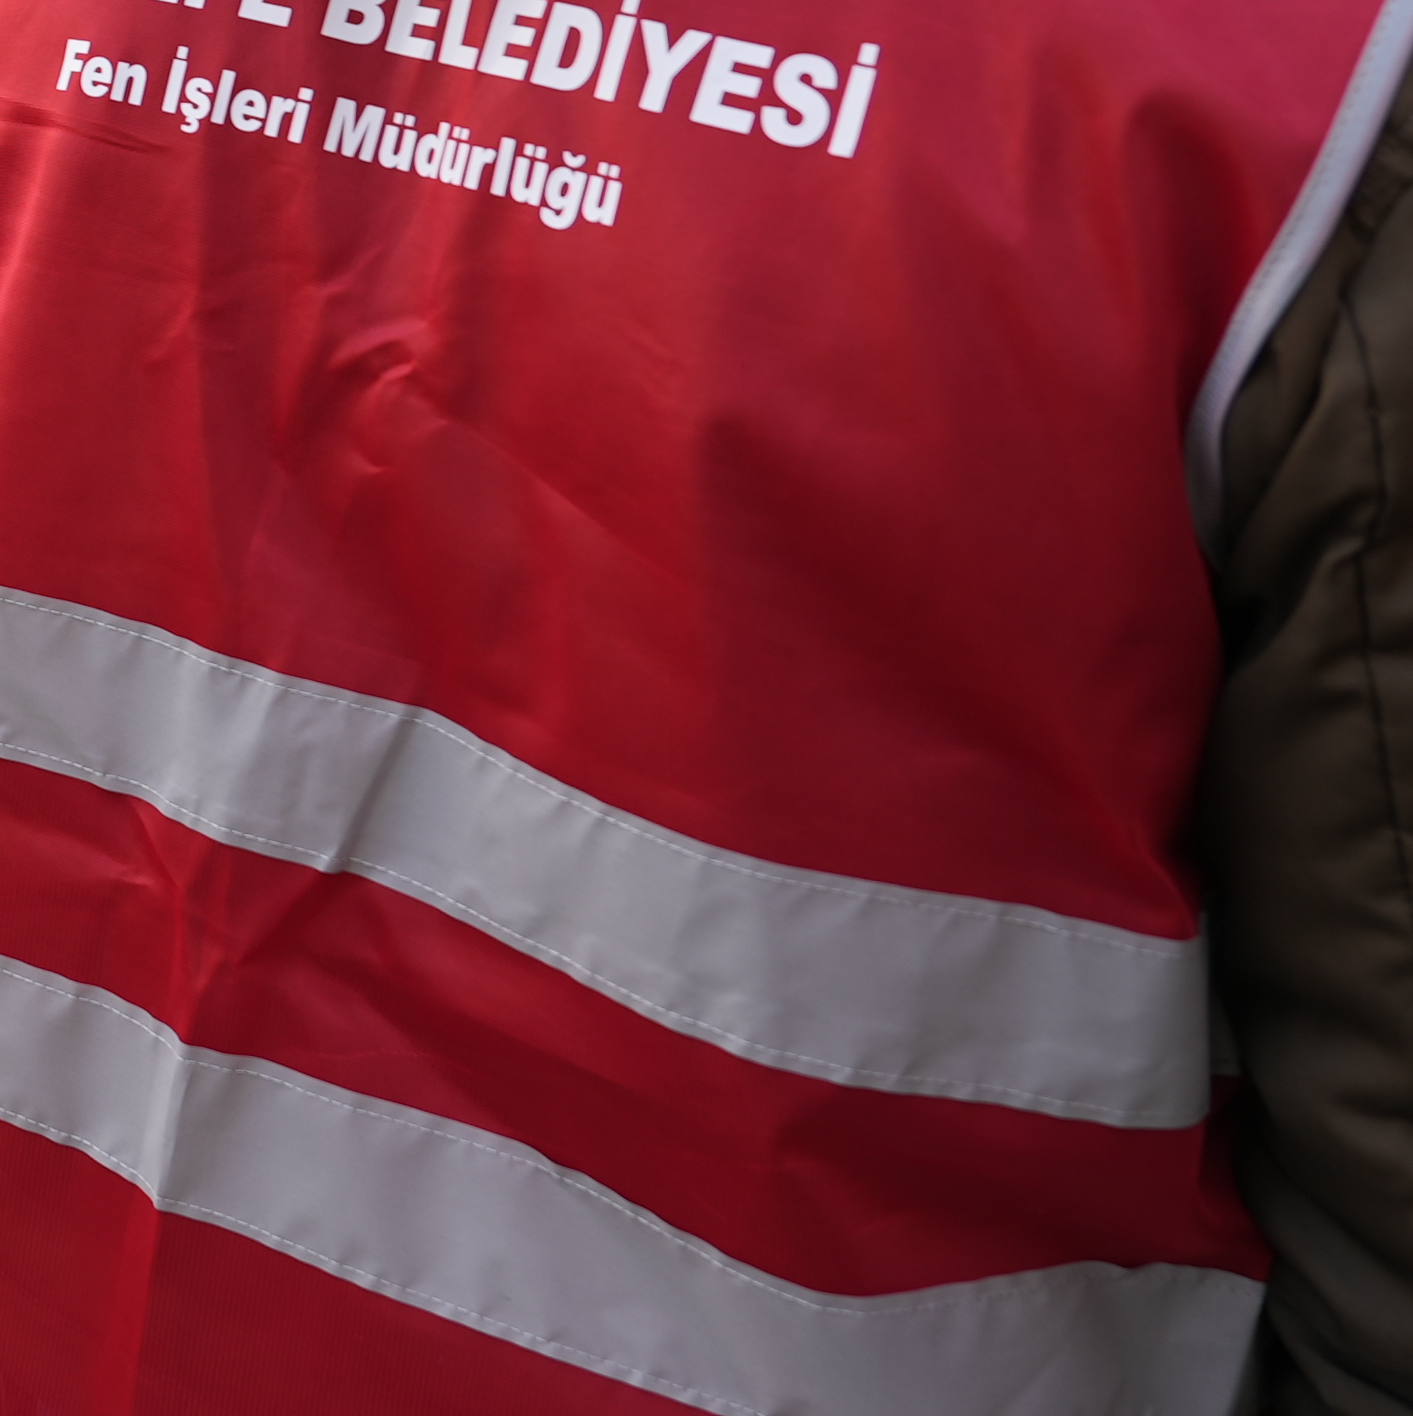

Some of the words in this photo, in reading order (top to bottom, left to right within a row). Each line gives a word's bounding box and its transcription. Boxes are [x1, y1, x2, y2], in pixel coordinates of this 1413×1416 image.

[55, 38, 148, 107] Fen
[160, 45, 315, 145] İşleri
[322, 97, 624, 231] Müdürlüğü
